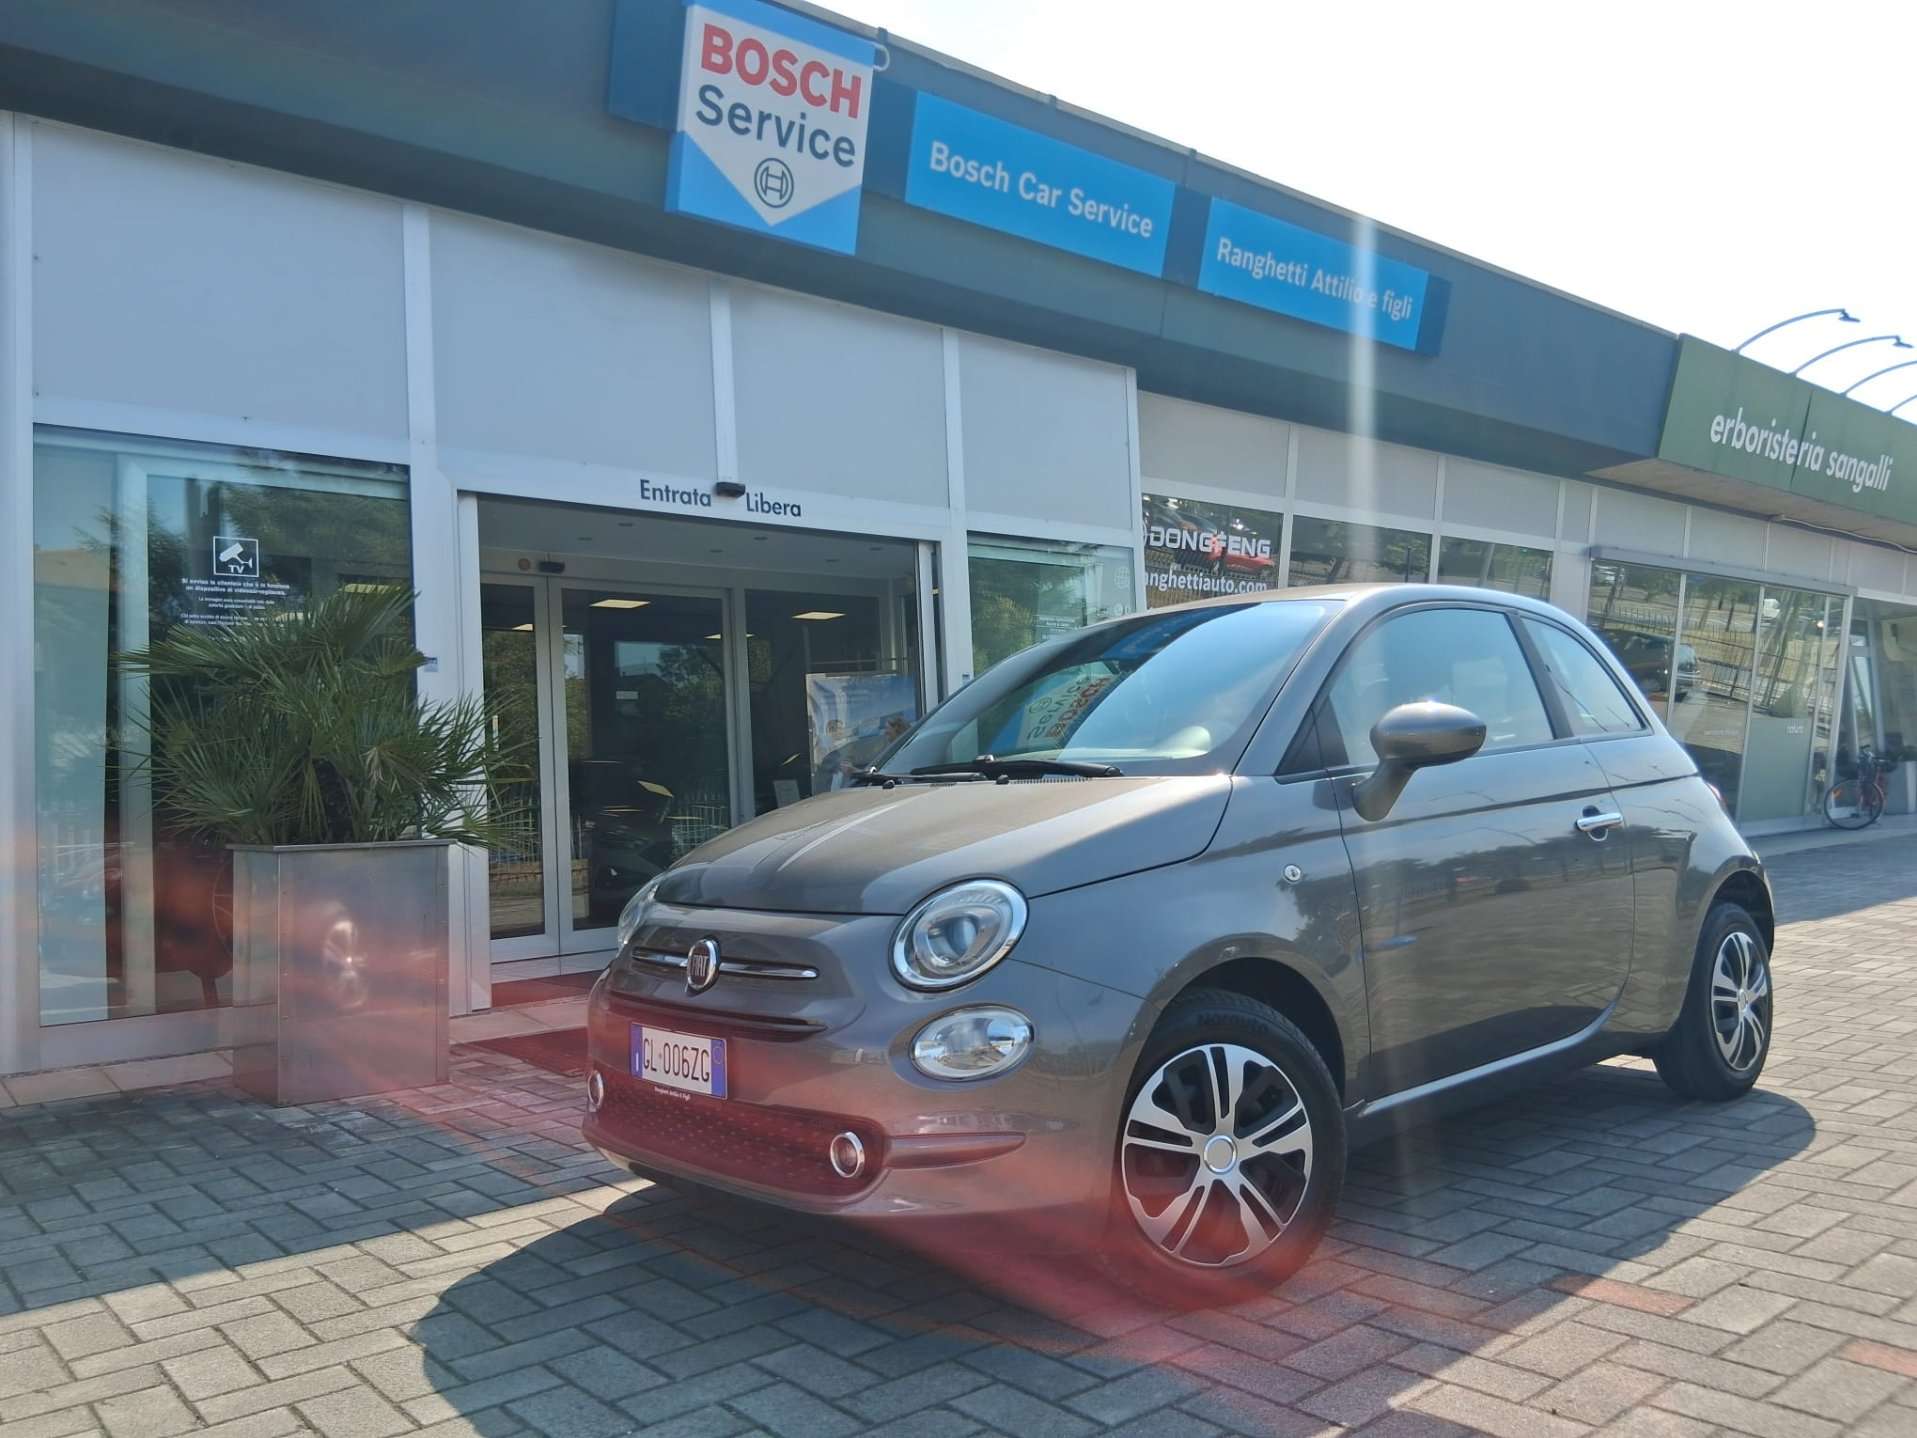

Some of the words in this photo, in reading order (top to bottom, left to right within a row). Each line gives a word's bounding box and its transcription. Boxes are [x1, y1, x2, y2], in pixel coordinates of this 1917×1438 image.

[700, 23, 862, 119] BOSCH
[695, 84, 856, 167] Service
[930, 140, 1010, 193] Bosch
[1018, 171, 1063, 209] Car
[1067, 188, 1153, 238] Service
[1217, 236, 1308, 287] Ranghetti
[1311, 268, 1362, 304] Attilio
[1367, 290, 1378, 309] e
[1382, 289, 1413, 321] figli
[1710, 407, 1825, 472] erboristeria
[1826, 451, 1894, 493] sangalli
[640, 479, 712, 507] Entrata
[746, 492, 802, 517] Libera
[228, 564, 245, 574] TV
[1150, 527, 1272, 559] DONGFENG
